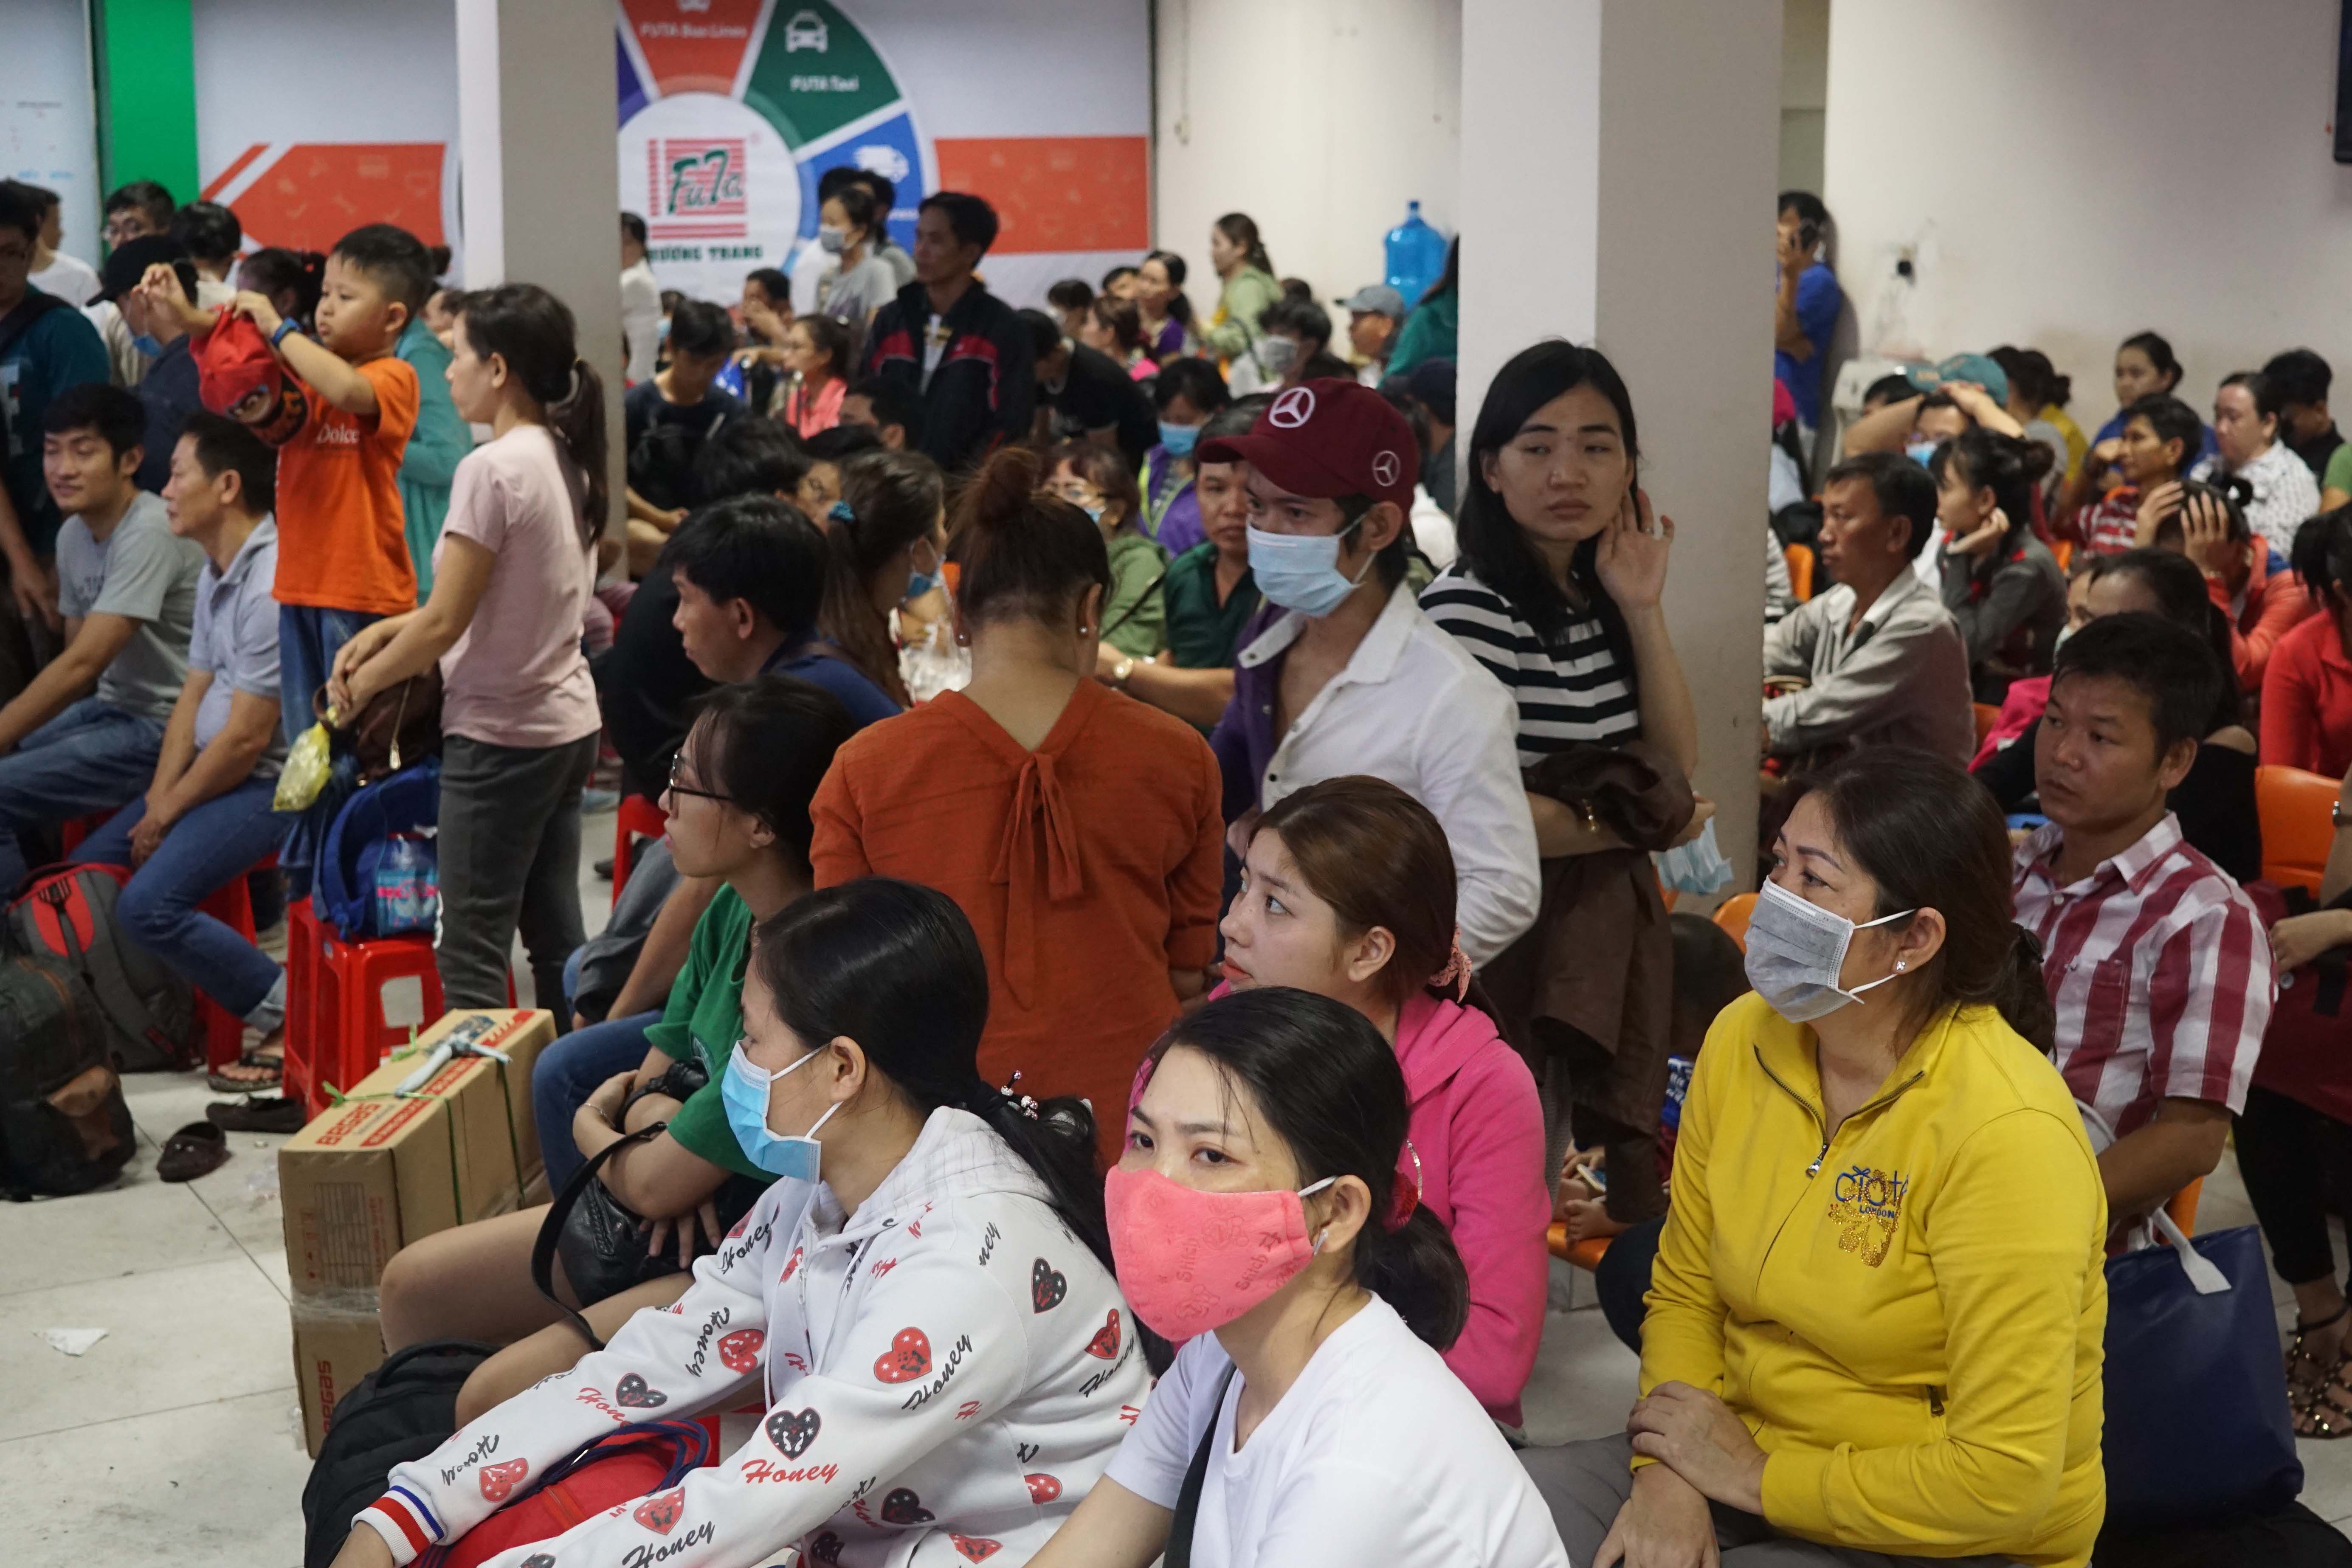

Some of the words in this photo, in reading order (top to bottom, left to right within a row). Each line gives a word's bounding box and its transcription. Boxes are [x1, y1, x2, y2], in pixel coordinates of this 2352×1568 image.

[685, 1307, 730, 1377] Honey
[901, 1334, 972, 1410] Honey
[575, 1387, 632, 1427] Hone
[741, 1459, 839, 1484] Honey
[622, 1520, 715, 1568] Honey
